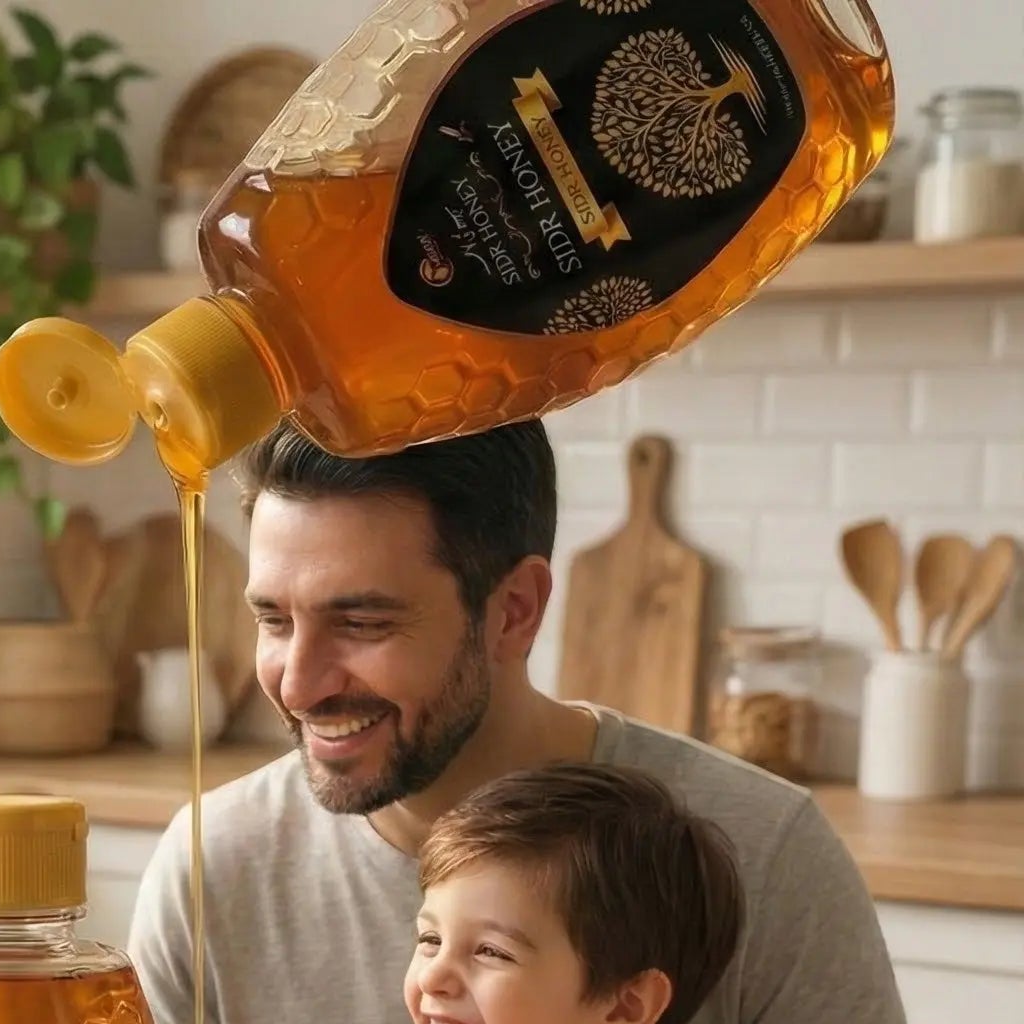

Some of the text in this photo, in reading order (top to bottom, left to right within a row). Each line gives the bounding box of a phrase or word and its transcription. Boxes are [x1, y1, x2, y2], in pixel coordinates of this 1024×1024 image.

[450, 178, 499, 243] HONEY
[487, 122, 582, 273] SIDR HONEY
[531, 117, 596, 225] SIDR HONEY
[490, 240, 521, 285] SIDR
